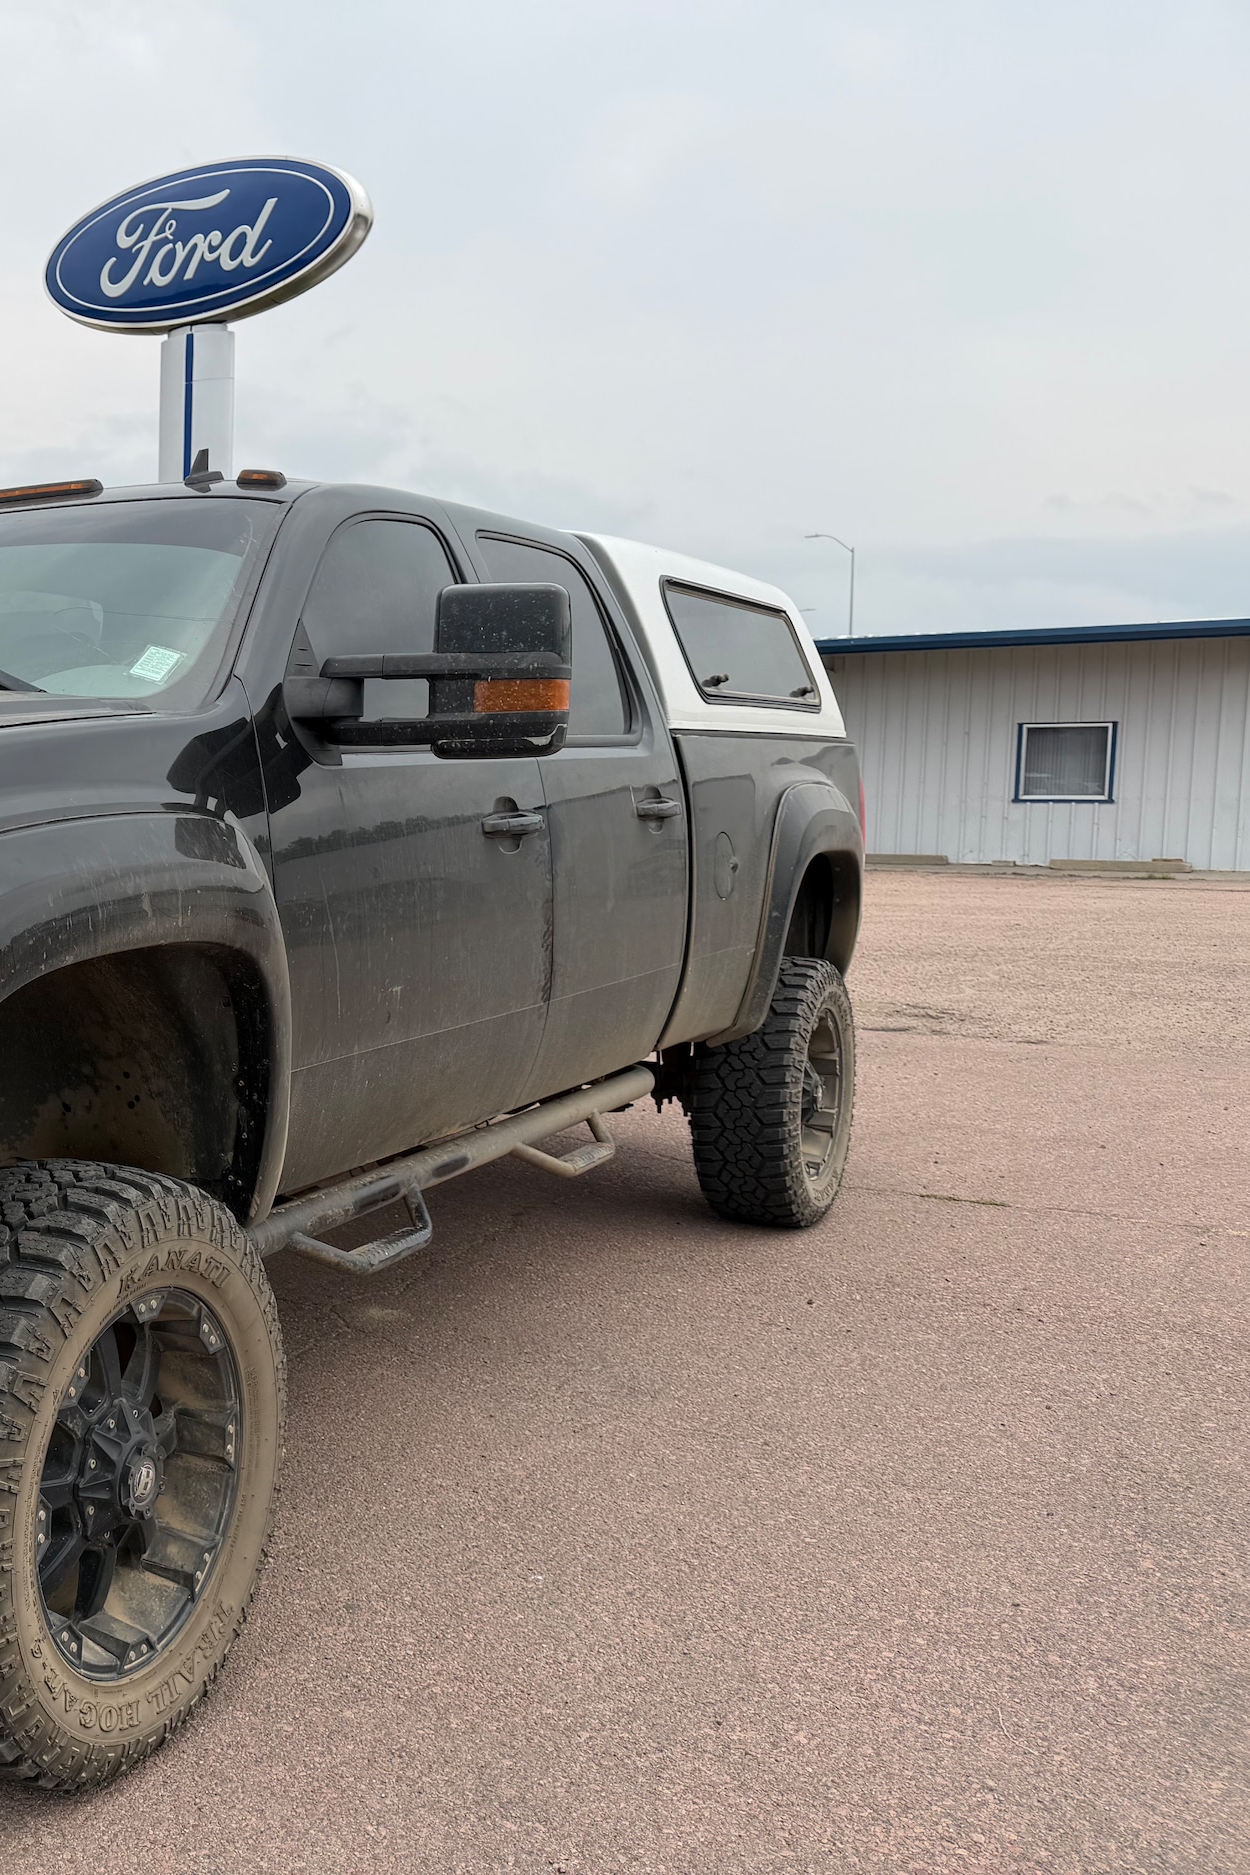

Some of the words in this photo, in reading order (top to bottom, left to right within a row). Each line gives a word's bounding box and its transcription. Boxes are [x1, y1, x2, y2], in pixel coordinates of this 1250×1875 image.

[100, 188, 278, 299] Ford
[116, 1247, 233, 1299] KANATI
[145, 1599, 235, 1715] TRAIL
[79, 1699, 142, 1733] HOG
